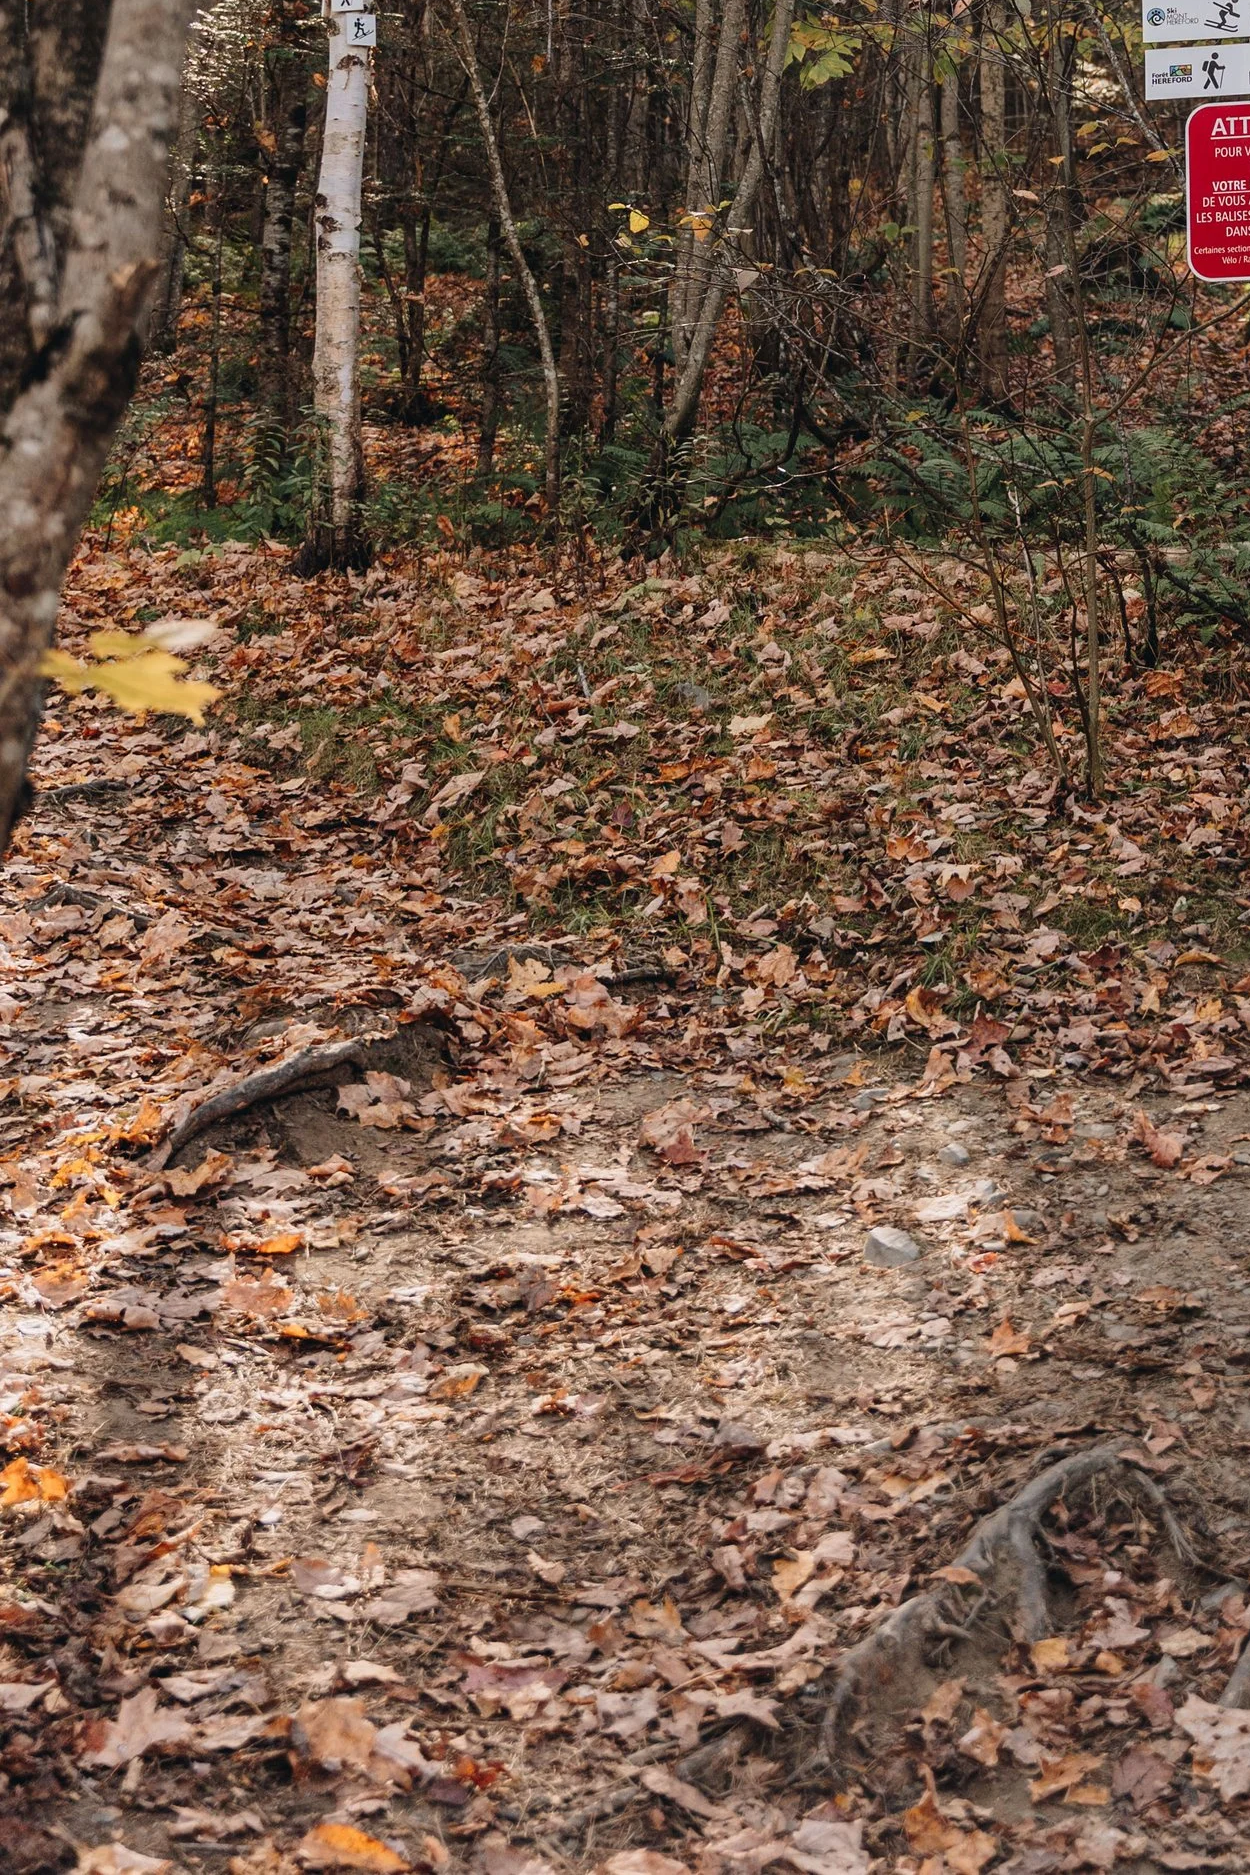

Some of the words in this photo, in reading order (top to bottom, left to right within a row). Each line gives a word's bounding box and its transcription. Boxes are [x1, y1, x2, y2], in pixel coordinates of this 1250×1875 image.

[1152, 76, 1192, 84] HEREFORD
[1215, 147, 1242, 158] POUR
[1212, 180, 1246, 192] VOTRE
[1203, 196, 1215, 207] DE
[1218, 195, 1246, 206] VOUS
[1196, 213, 1212, 223] LES
[1194, 246, 1225, 254] Certaines
[1222, 255, 1237, 264] Vélo
